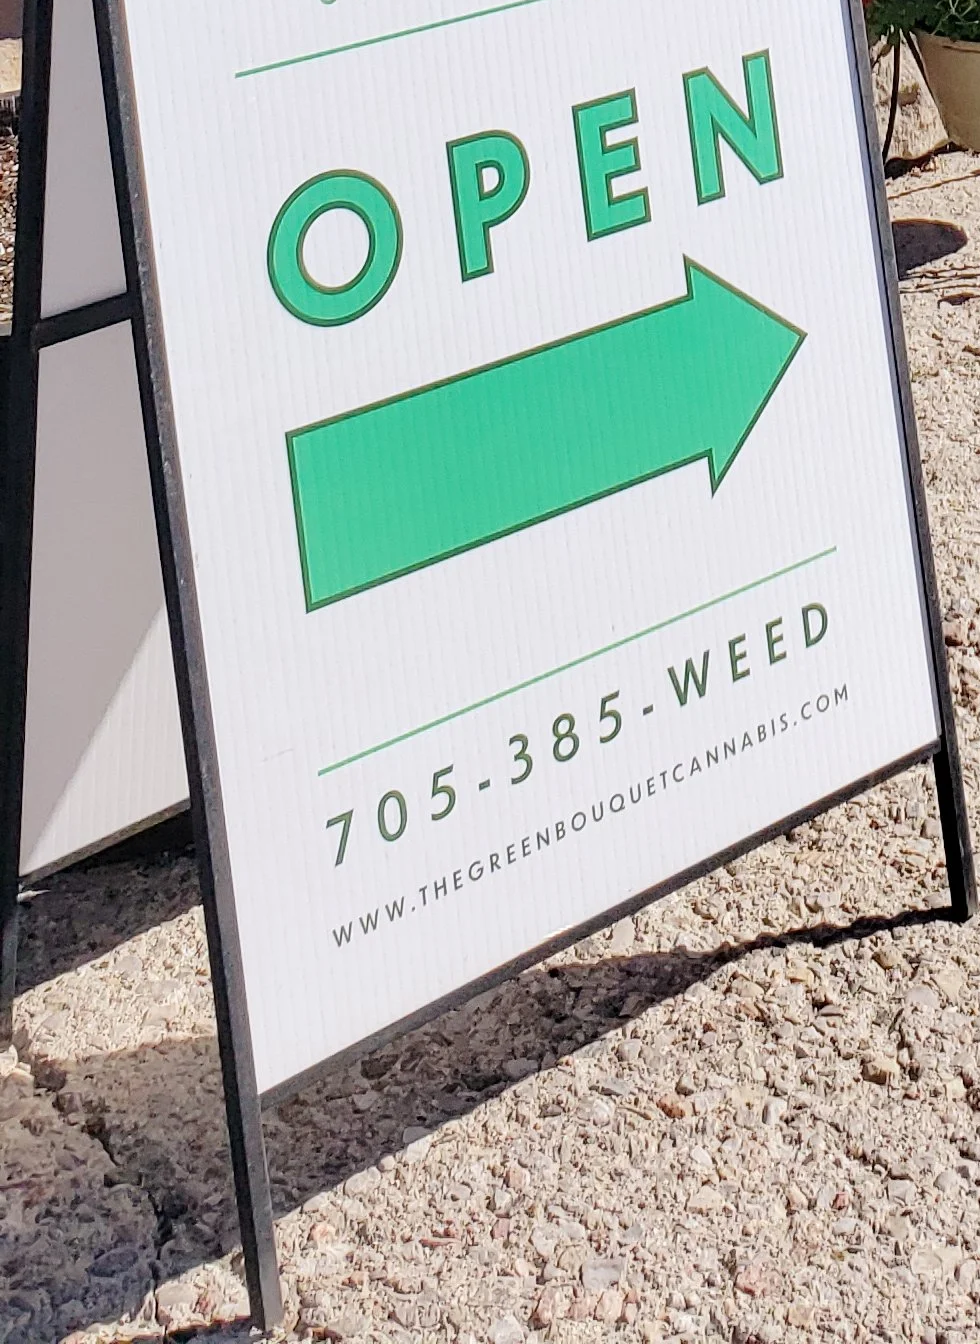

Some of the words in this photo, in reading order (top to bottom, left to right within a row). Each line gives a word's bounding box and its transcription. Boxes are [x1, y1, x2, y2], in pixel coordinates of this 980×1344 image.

[266, 48, 784, 327] OPEN
[325, 602, 830, 868] 705-385-WEED
[332, 683, 850, 949] WWW.THEGREENBOUQUETCANNABIS.COM
